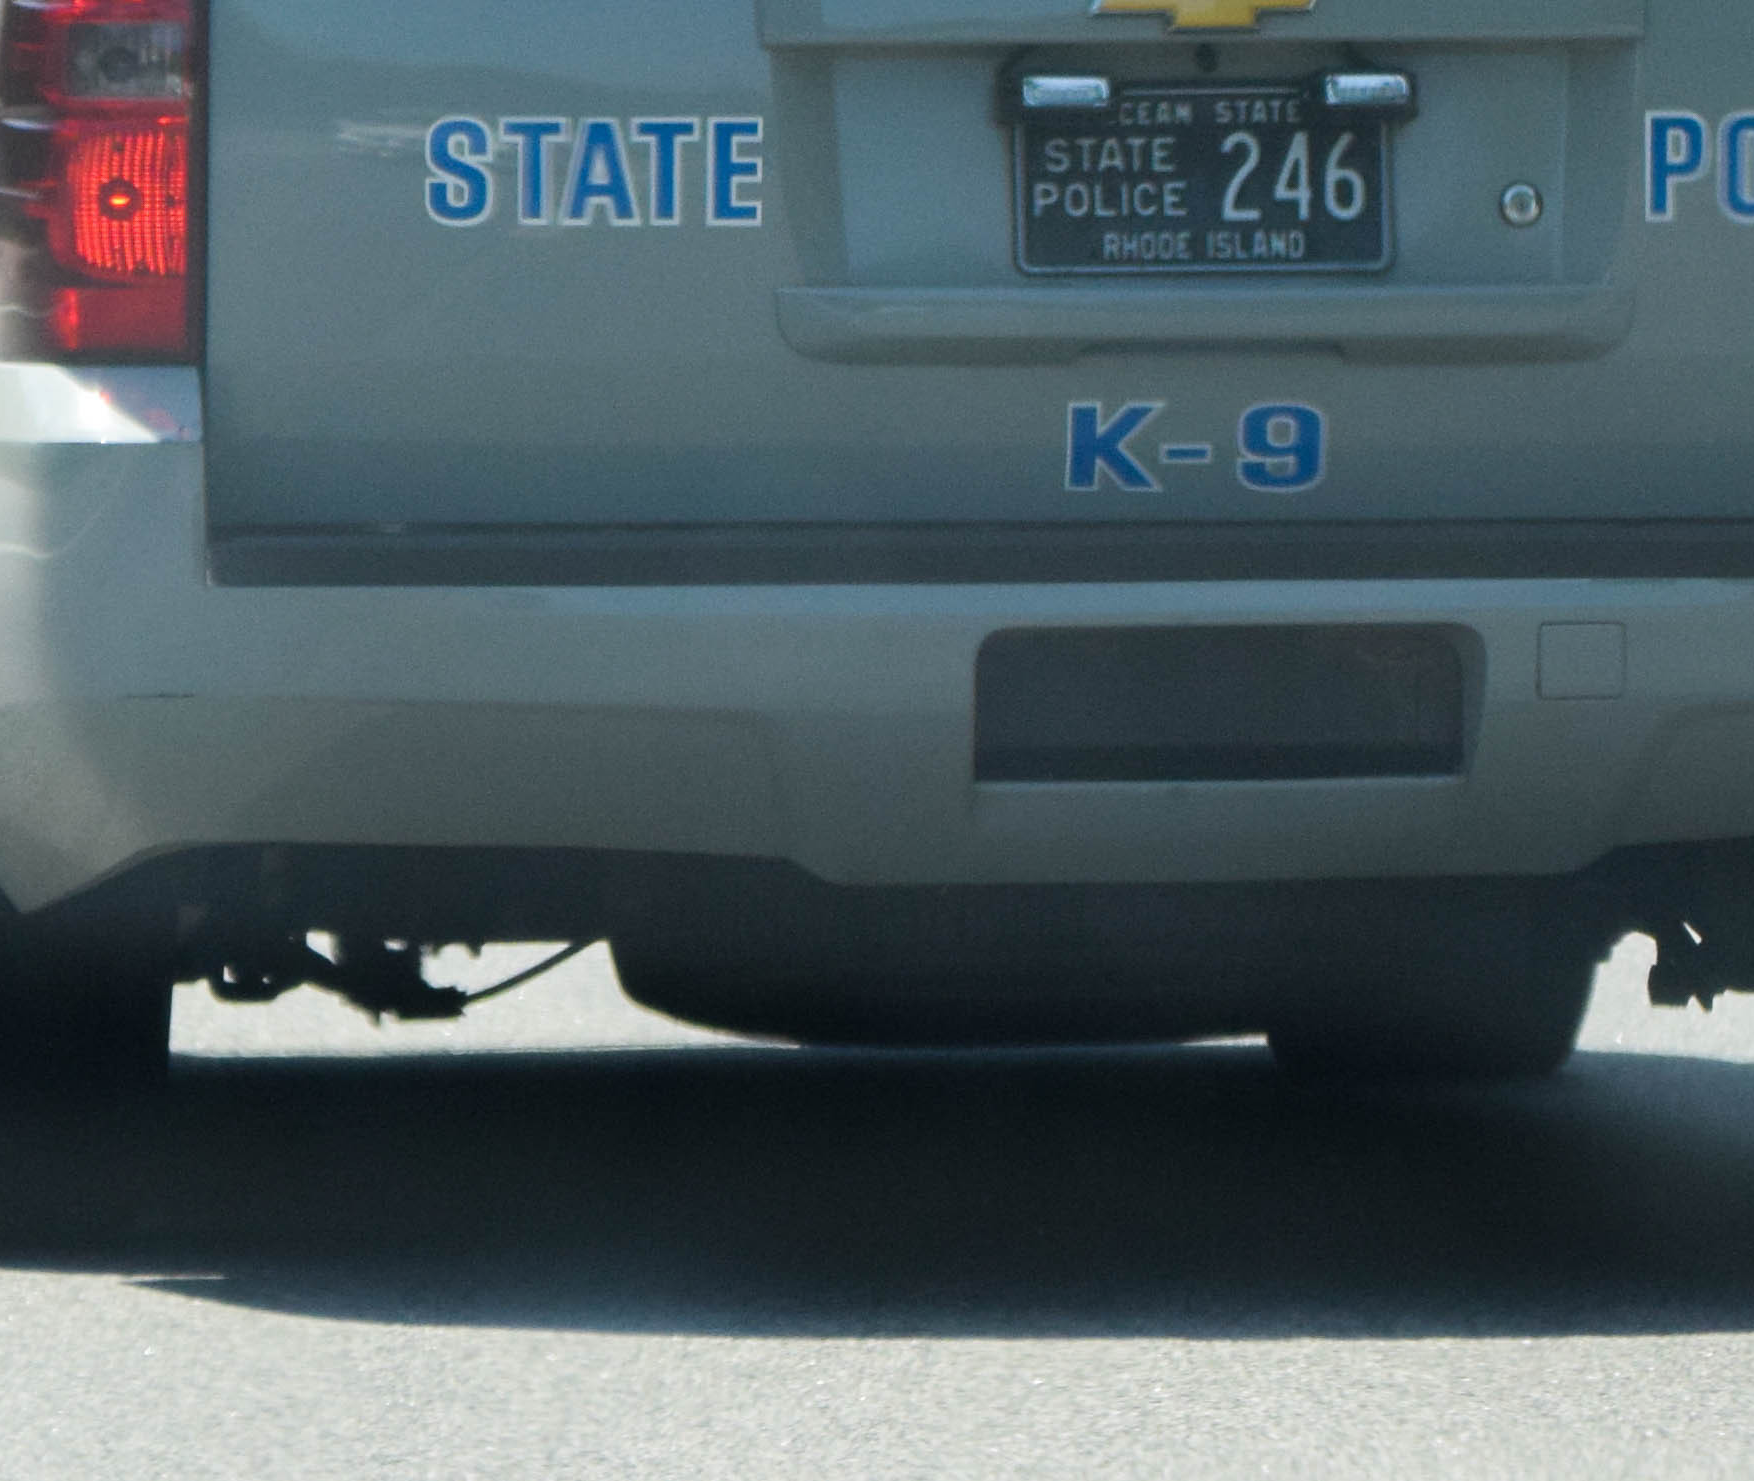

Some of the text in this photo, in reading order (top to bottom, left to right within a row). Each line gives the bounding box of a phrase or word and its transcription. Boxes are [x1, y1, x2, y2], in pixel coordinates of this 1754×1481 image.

[1112, 98, 1301, 126] CEAN STATE
[425, 116, 763, 226] STATE
[1045, 137, 1177, 173] STATE
[1219, 131, 1365, 222] 246
[1032, 181, 1189, 219] POLICE
[1103, 231, 1305, 260] RHODE ISLAND
[1065, 401, 1325, 493] K-9
